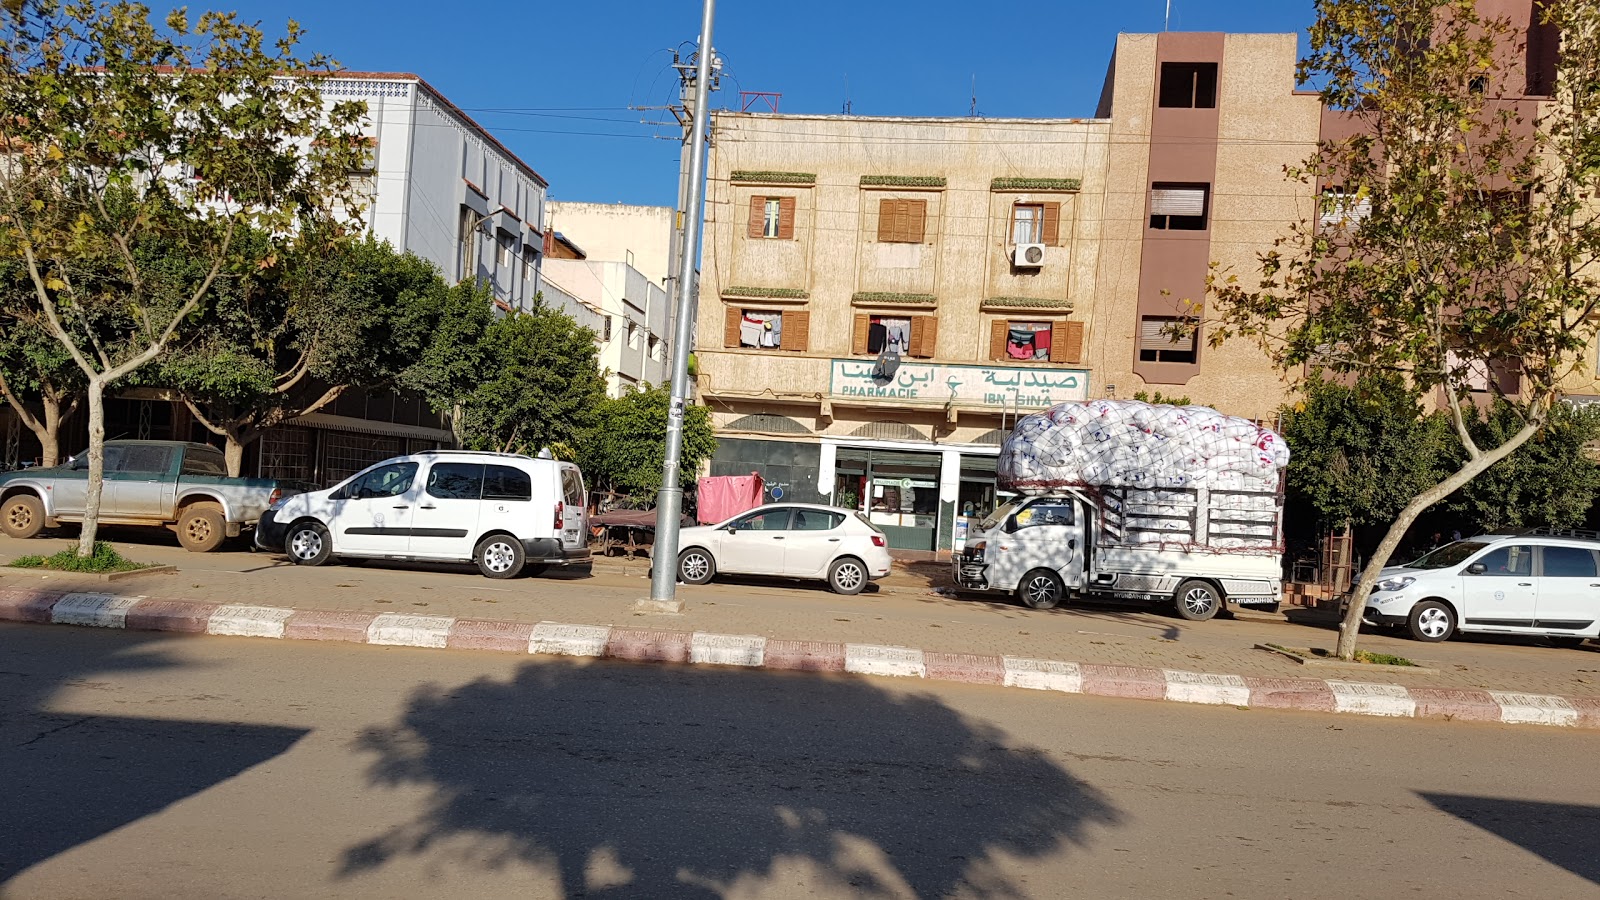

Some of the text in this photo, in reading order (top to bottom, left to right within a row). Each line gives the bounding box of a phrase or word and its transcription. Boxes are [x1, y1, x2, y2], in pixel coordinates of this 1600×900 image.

[898, 368, 935, 388] ابن
[982, 370, 1078, 393] صيدلية
[842, 385, 1052, 406] PHARMACIE IBN SINA
